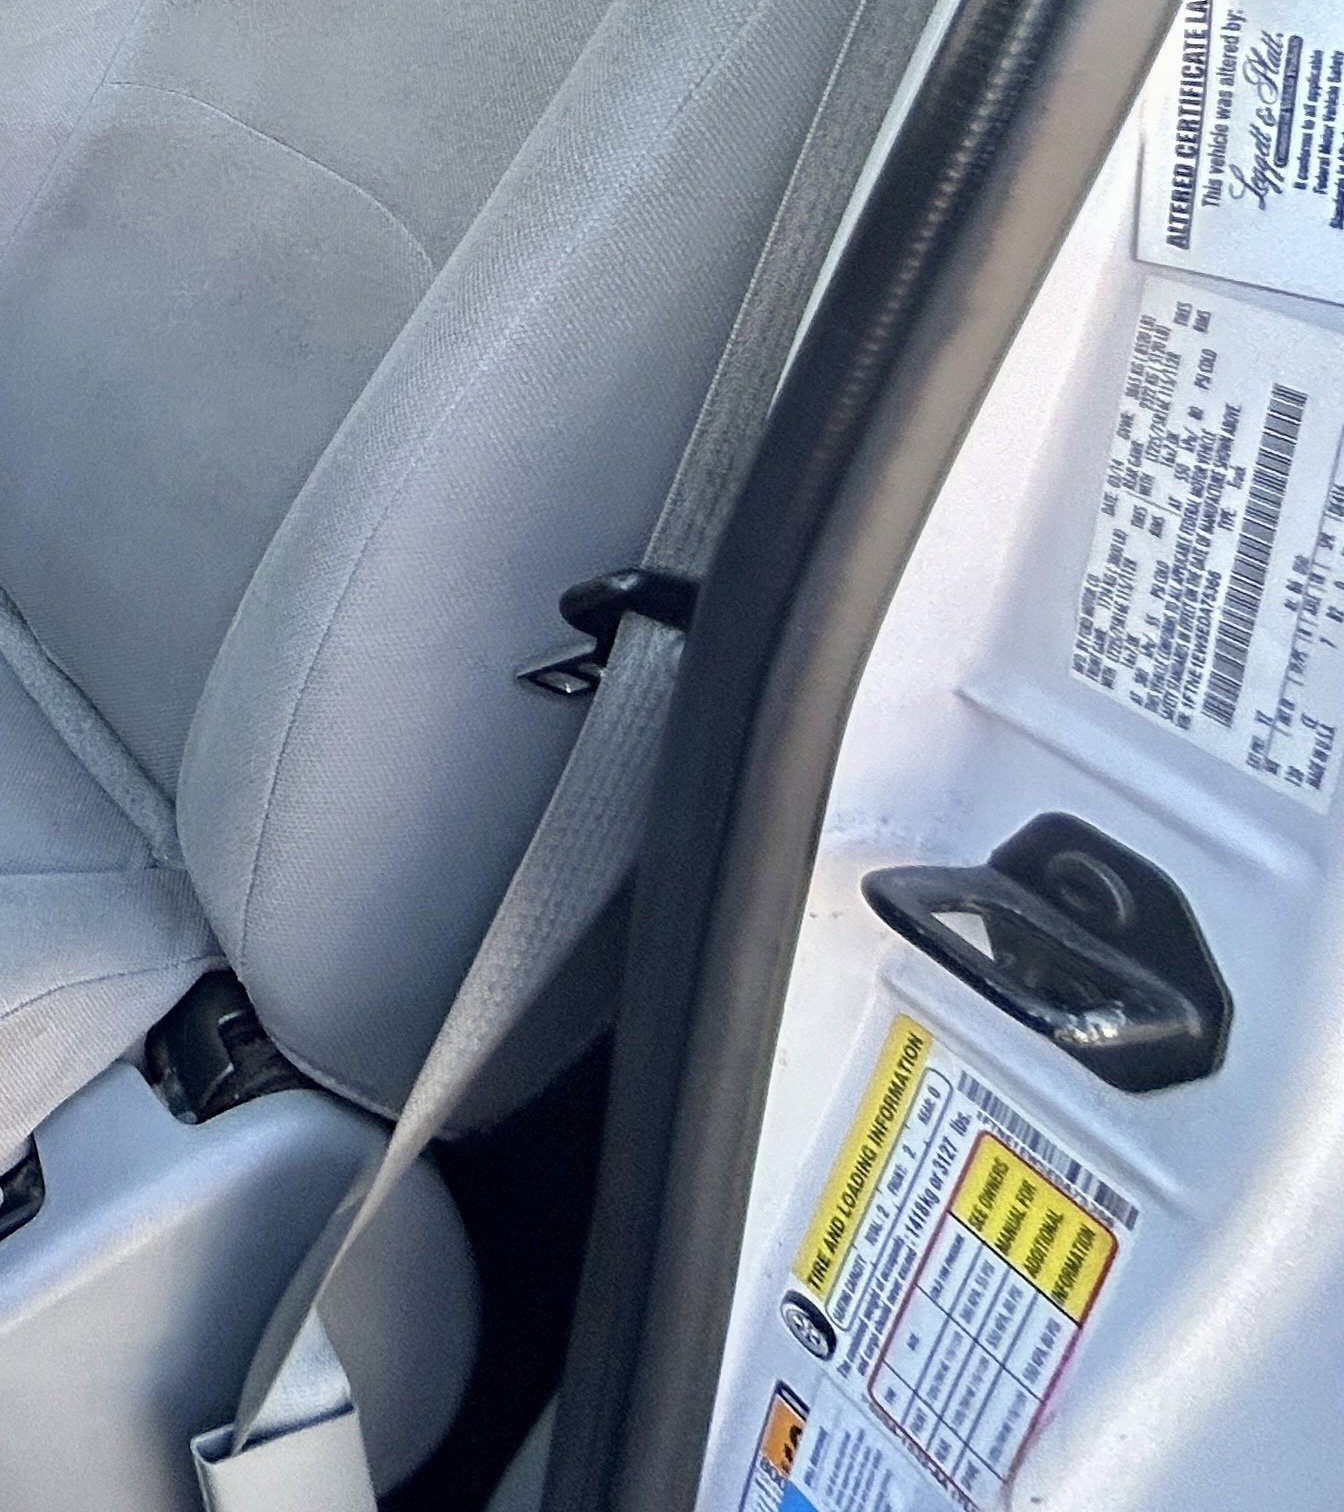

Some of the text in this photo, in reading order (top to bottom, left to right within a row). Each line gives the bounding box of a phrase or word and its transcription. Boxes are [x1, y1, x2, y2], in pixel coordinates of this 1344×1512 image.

[1171, 28, 1208, 159] CERTIFICATE
[1201, 7, 1247, 207] This vehicle was altered by:
[1254, 105, 1277, 127] &
[1164, 163, 1194, 248] ALTERED
[1224, 122, 1289, 211] Leggett
[804, 1030, 926, 1291] TIRE AND LOADING INFORMATION
[875, 1203, 890, 1219] 2
[901, 1142, 916, 1159] 2
[903, 1103, 972, 1241] 1418kg or 3127 lbs.
[975, 1155, 1010, 1211] OWNERS
[966, 1203, 988, 1232] SEE
[992, 1200, 1027, 1256] MANUAL
[1014, 1176, 1037, 1209] FOR
[1020, 1202, 1065, 1279] ADDITIONAL
[1048, 1222, 1096, 1306] INFORMATION
